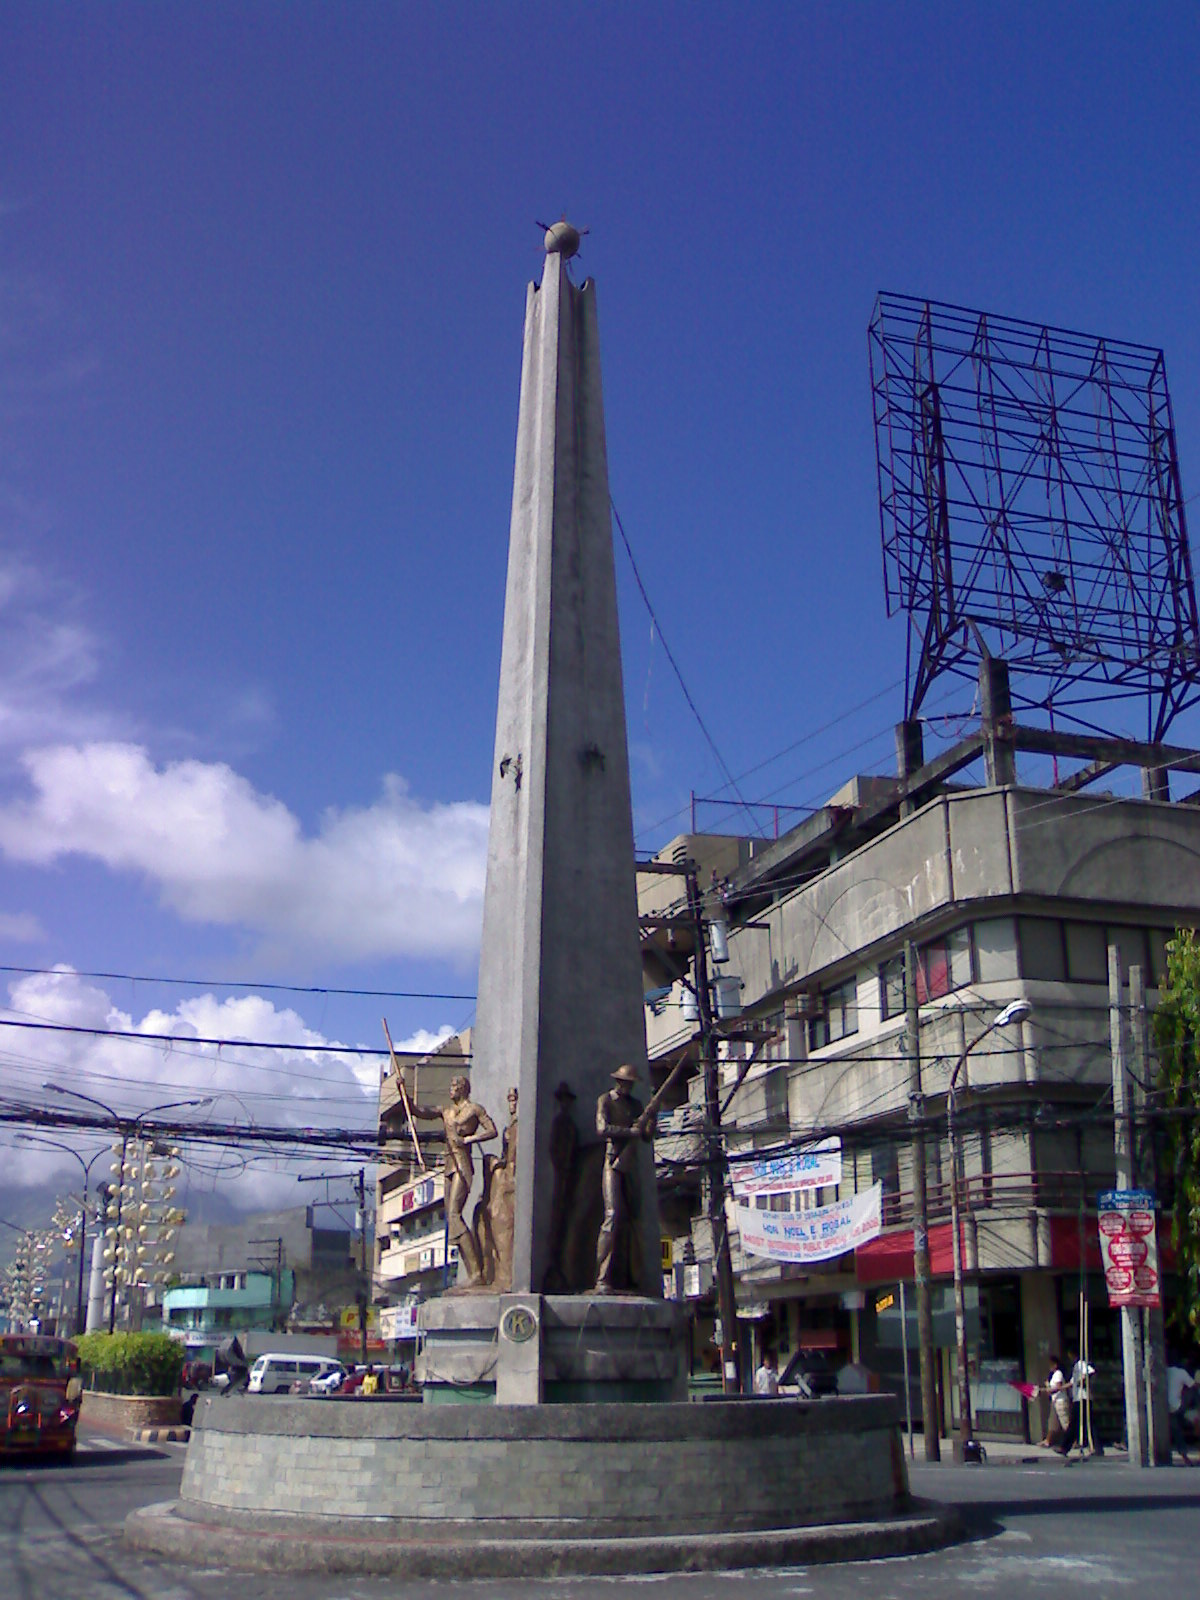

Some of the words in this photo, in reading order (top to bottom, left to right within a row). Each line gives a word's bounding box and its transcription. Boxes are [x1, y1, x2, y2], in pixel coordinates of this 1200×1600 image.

[784, 1226, 806, 1240] NOEL
[810, 1225, 816, 1235] E
[822, 1214, 852, 1233] ROSAL
